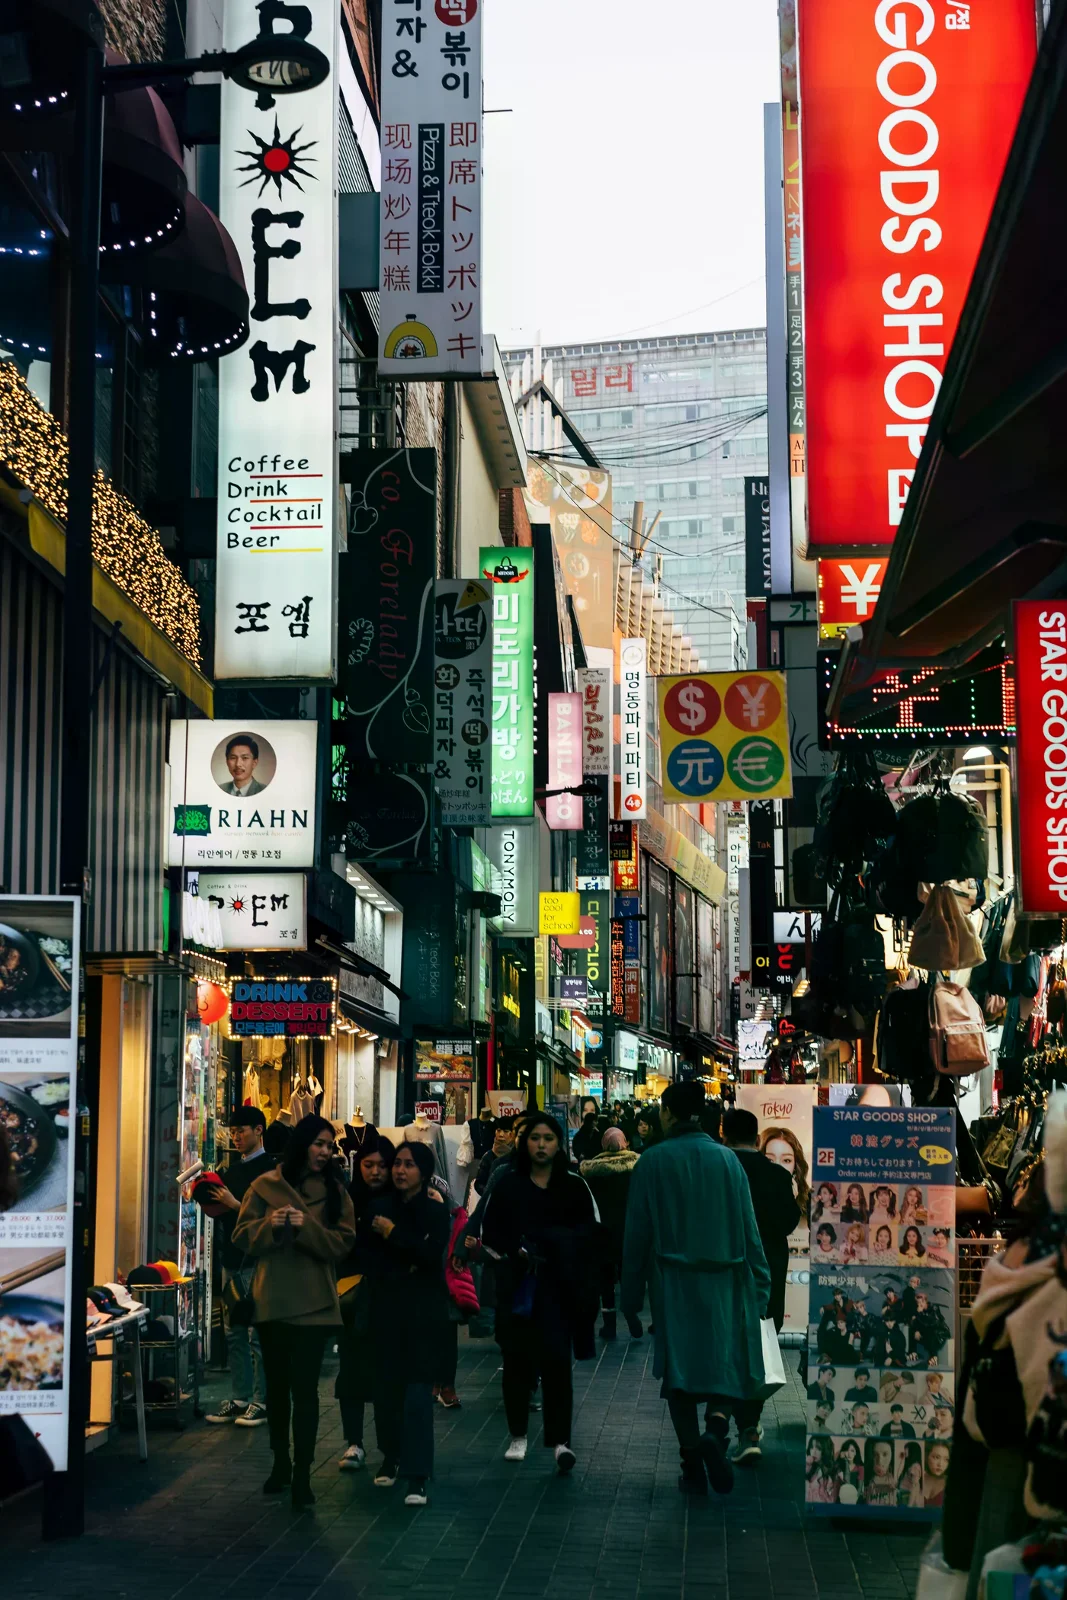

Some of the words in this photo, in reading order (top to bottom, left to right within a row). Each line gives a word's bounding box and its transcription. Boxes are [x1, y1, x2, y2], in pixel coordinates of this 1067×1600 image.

[875, 0, 943, 254] GOODS
[422, 127, 440, 172] Pizza
[422, 173, 440, 188] &
[384, 123, 412, 292] 现场炒年糕
[421, 191, 441, 240] Tteok
[421, 243, 441, 289] Bokki
[882, 272, 944, 459] SHOP
[571, 363, 634, 397] 밀리
[227, 455, 310, 473] Coffee
[226, 480, 289, 499] Drink
[226, 503, 322, 524] Cocktail
[226, 532, 281, 549] Beer
[234, 595, 314, 639] 포엠
[1038, 611, 1067, 682] STAR
[491, 592, 521, 763] 미도리가방
[464, 668, 486, 795] 즉석떡볶이
[625, 670, 642, 789] 명동파티파티
[556, 702, 573, 785] BANILA
[1041, 688, 1067, 810] GOODS
[218, 809, 308, 828] RIAHN
[197, 849, 233, 859] 리안헤어
[241, 849, 257, 859] 명동
[1045, 816, 1067, 902] SHOP
[503, 830, 516, 923] TONYMOLY
[543, 897, 560, 905] too
[543, 903, 564, 912] cool
[543, 914, 557, 922] for
[543, 921, 574, 931] school
[587, 900, 600, 981] CLCLIO
[234, 983, 308, 1002] DRINK
[312, 983, 330, 1002] &
[231, 1002, 331, 1021] DESSERT
[833, 1110, 859, 1121] STAR
[862, 1111, 905, 1123] GOODS
[907, 1112, 938, 1124] SHOP
[850, 1134, 920, 1149] 韓流グッズ
[818, 1150, 835, 1164] 2F
[838, 1169, 857, 1178] Order
[858, 1170, 877, 1179] made
